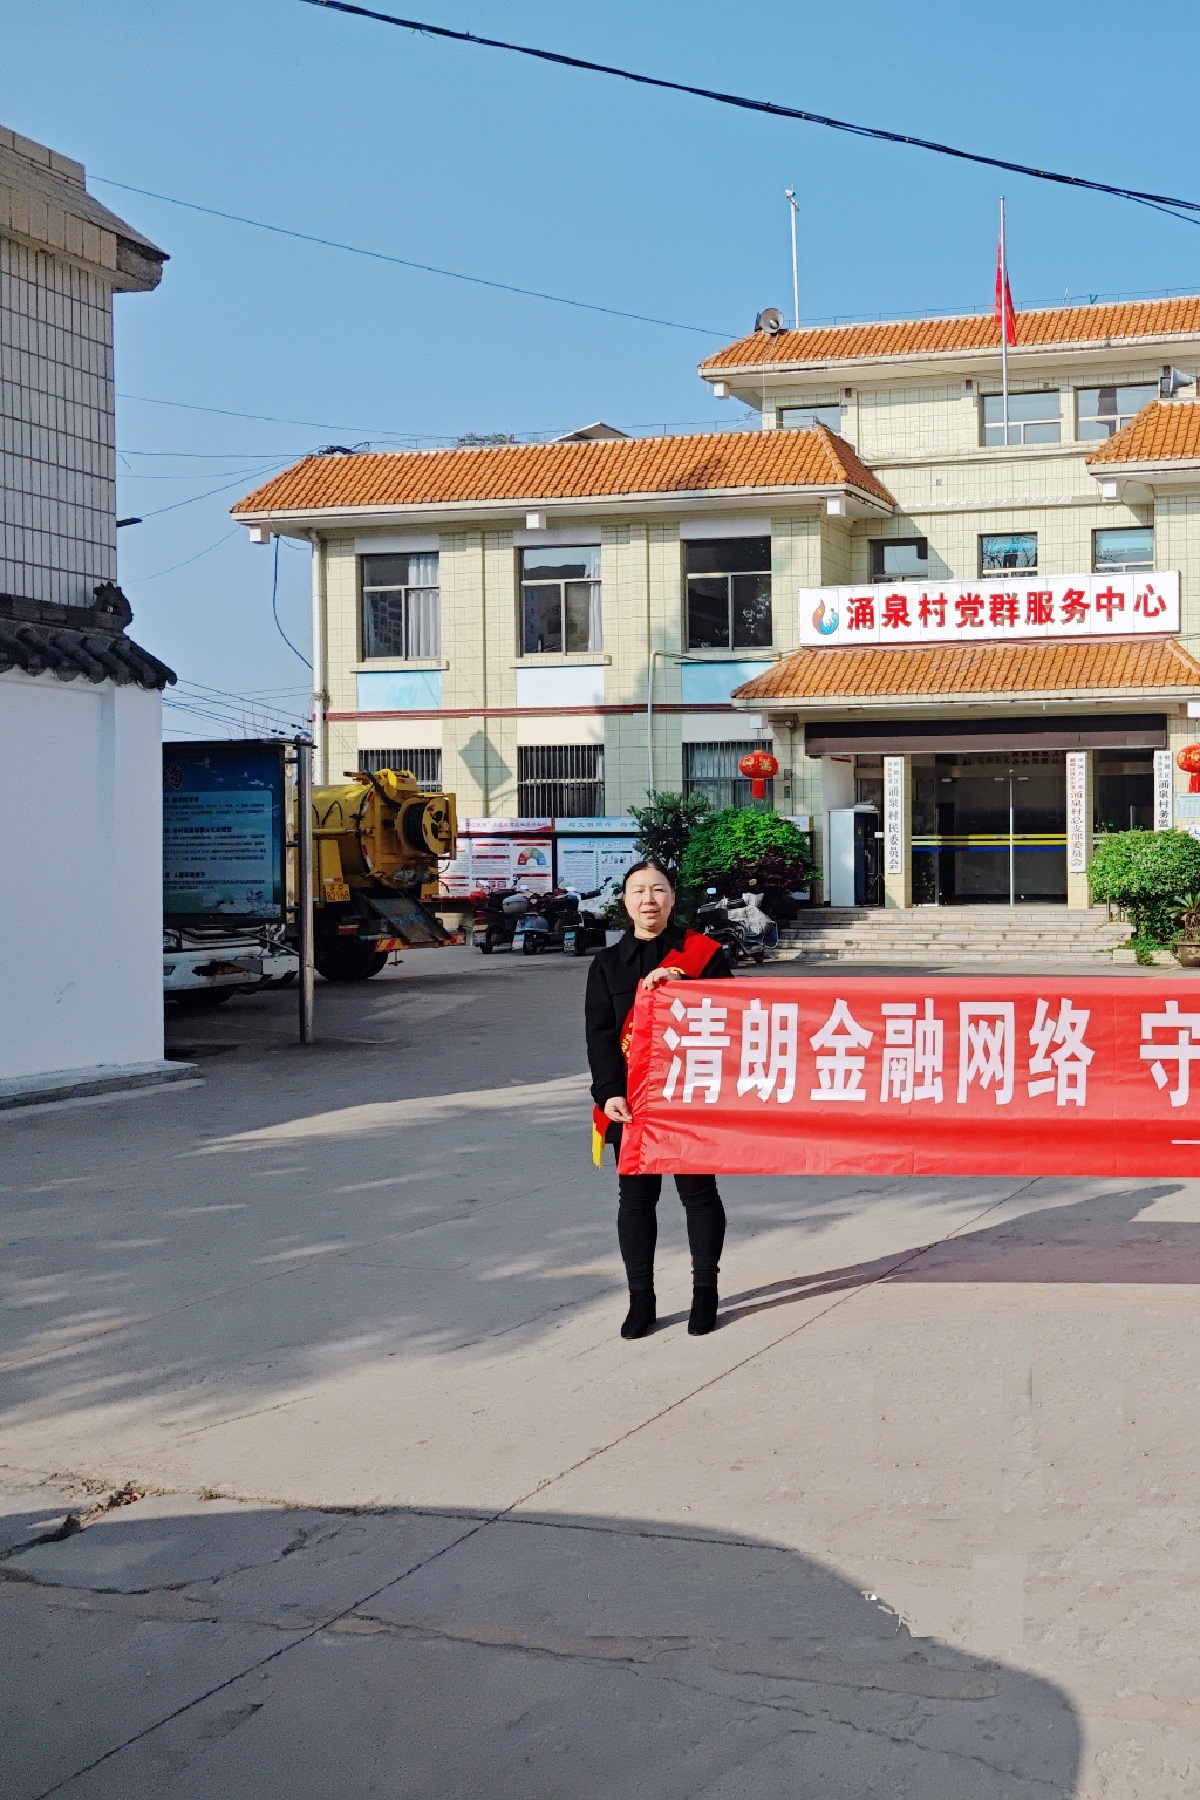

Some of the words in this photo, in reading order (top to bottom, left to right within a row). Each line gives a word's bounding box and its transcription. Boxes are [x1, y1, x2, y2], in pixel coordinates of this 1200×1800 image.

[846, 584, 1167, 630] 涌泉村党群服务中心
[661, 997, 1096, 1106] 清朗金融网络
